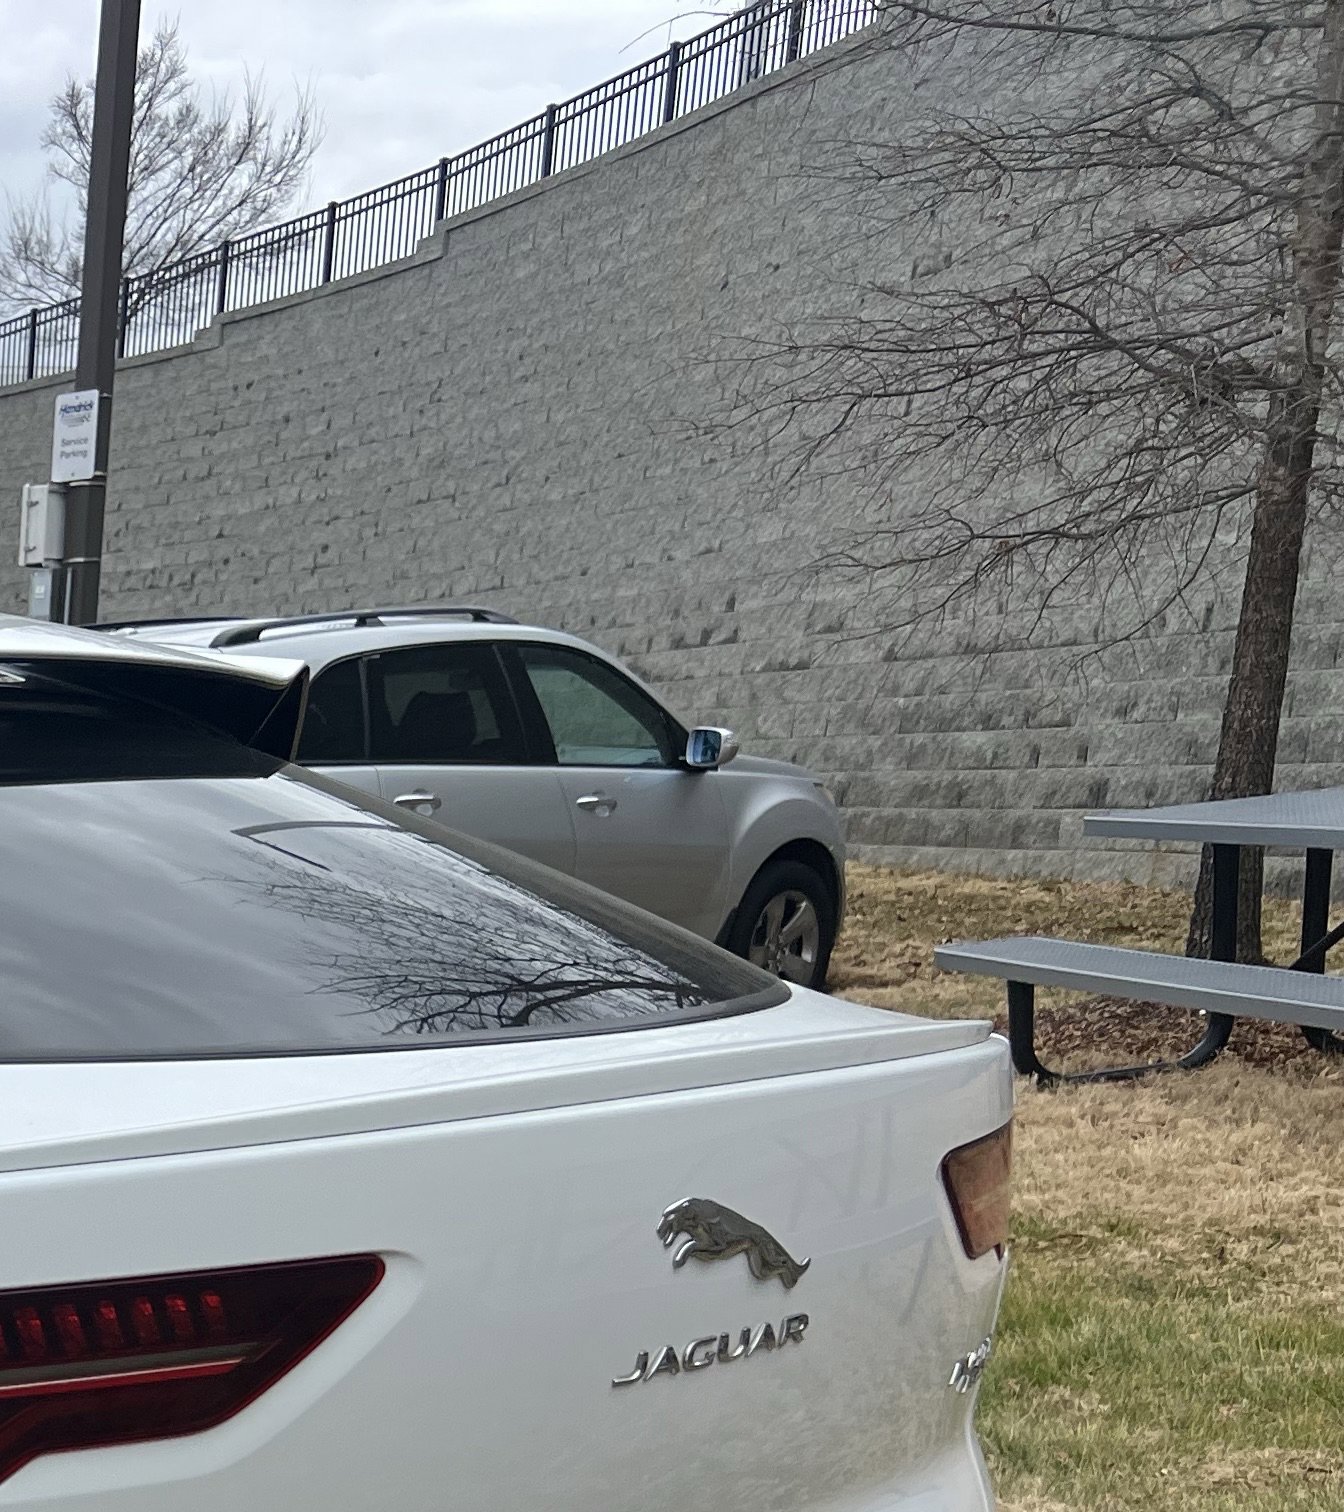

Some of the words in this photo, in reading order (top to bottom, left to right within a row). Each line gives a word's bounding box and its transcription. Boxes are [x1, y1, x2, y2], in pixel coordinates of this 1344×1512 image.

[59, 400, 95, 417] Hendrick
[61, 437, 89, 448] Service
[60, 449, 88, 459] Parking
[612, 1312, 810, 1387] JAGUAR
